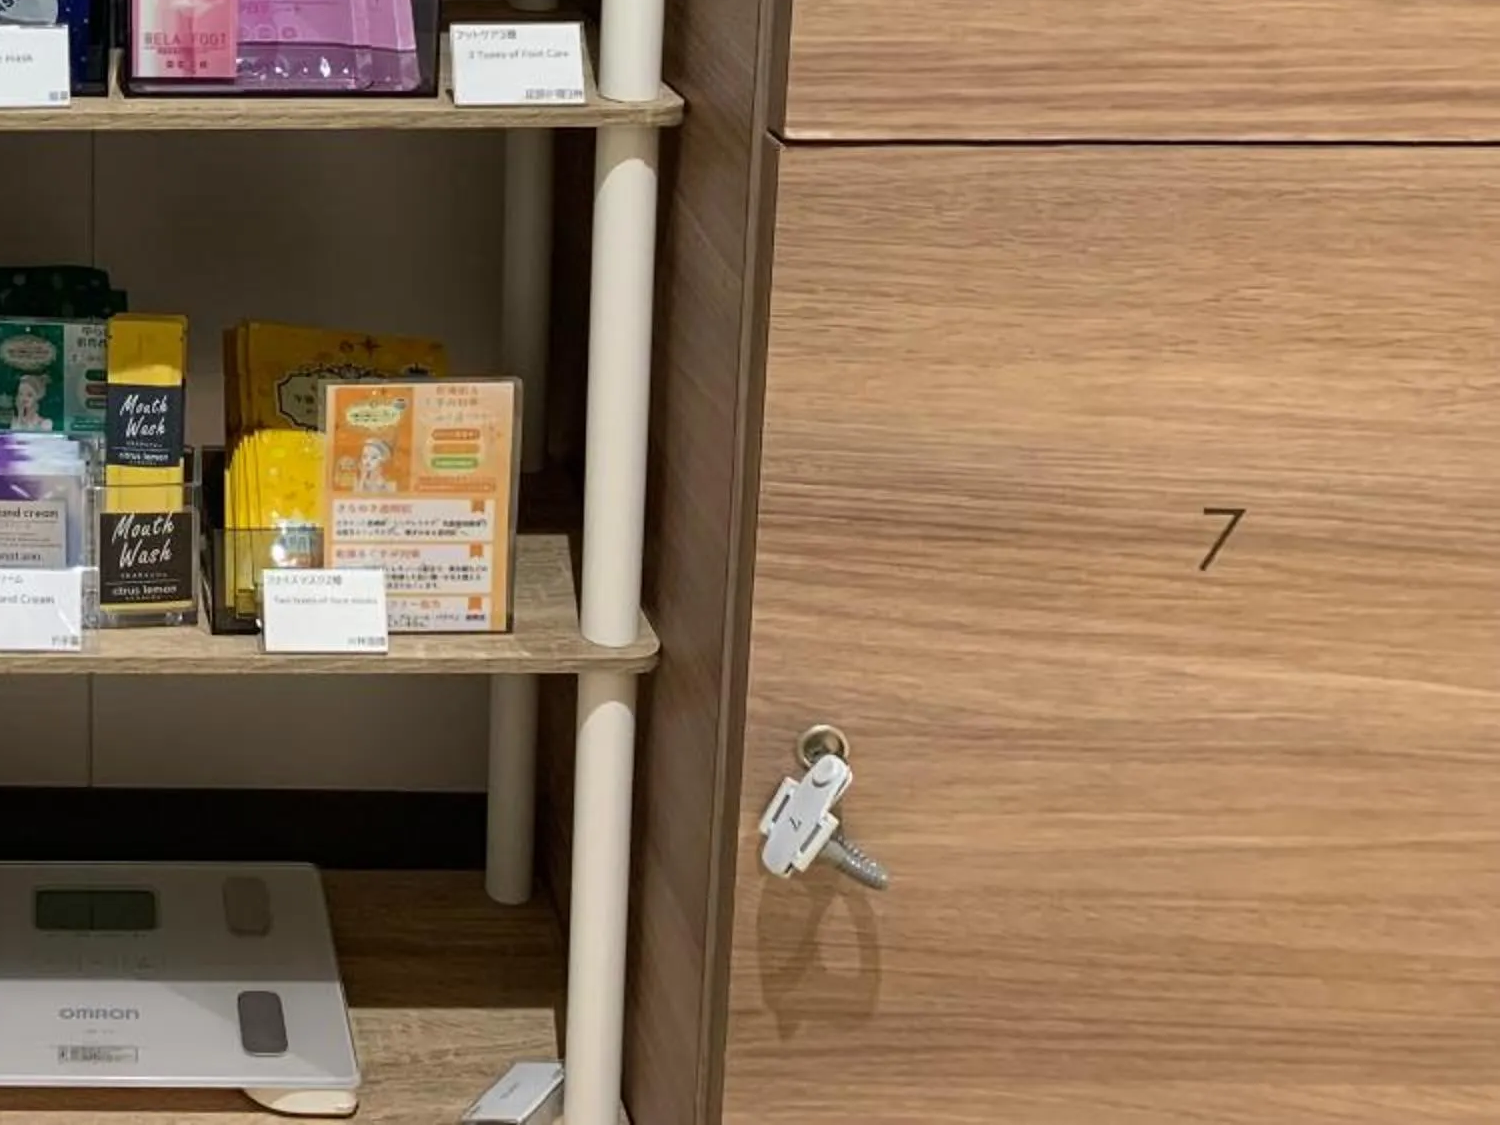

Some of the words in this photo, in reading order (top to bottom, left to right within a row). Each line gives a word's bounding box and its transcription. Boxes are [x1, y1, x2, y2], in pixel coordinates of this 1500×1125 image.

[521, 49, 545, 59] Foot
[547, 48, 571, 58] Care
[120, 394, 169, 416] Mouth
[125, 416, 166, 438] Wash
[23, 510, 59, 518] cream
[112, 512, 174, 543] Mouth
[1201, 508, 1247, 571] 7
[118, 539, 172, 568] Wash
[111, 586, 141, 596] citrus
[143, 584, 177, 595] lemon
[20, 593, 55, 604] Cream
[789, 817, 803, 832] 7
[58, 1007, 141, 1020] OMRON
